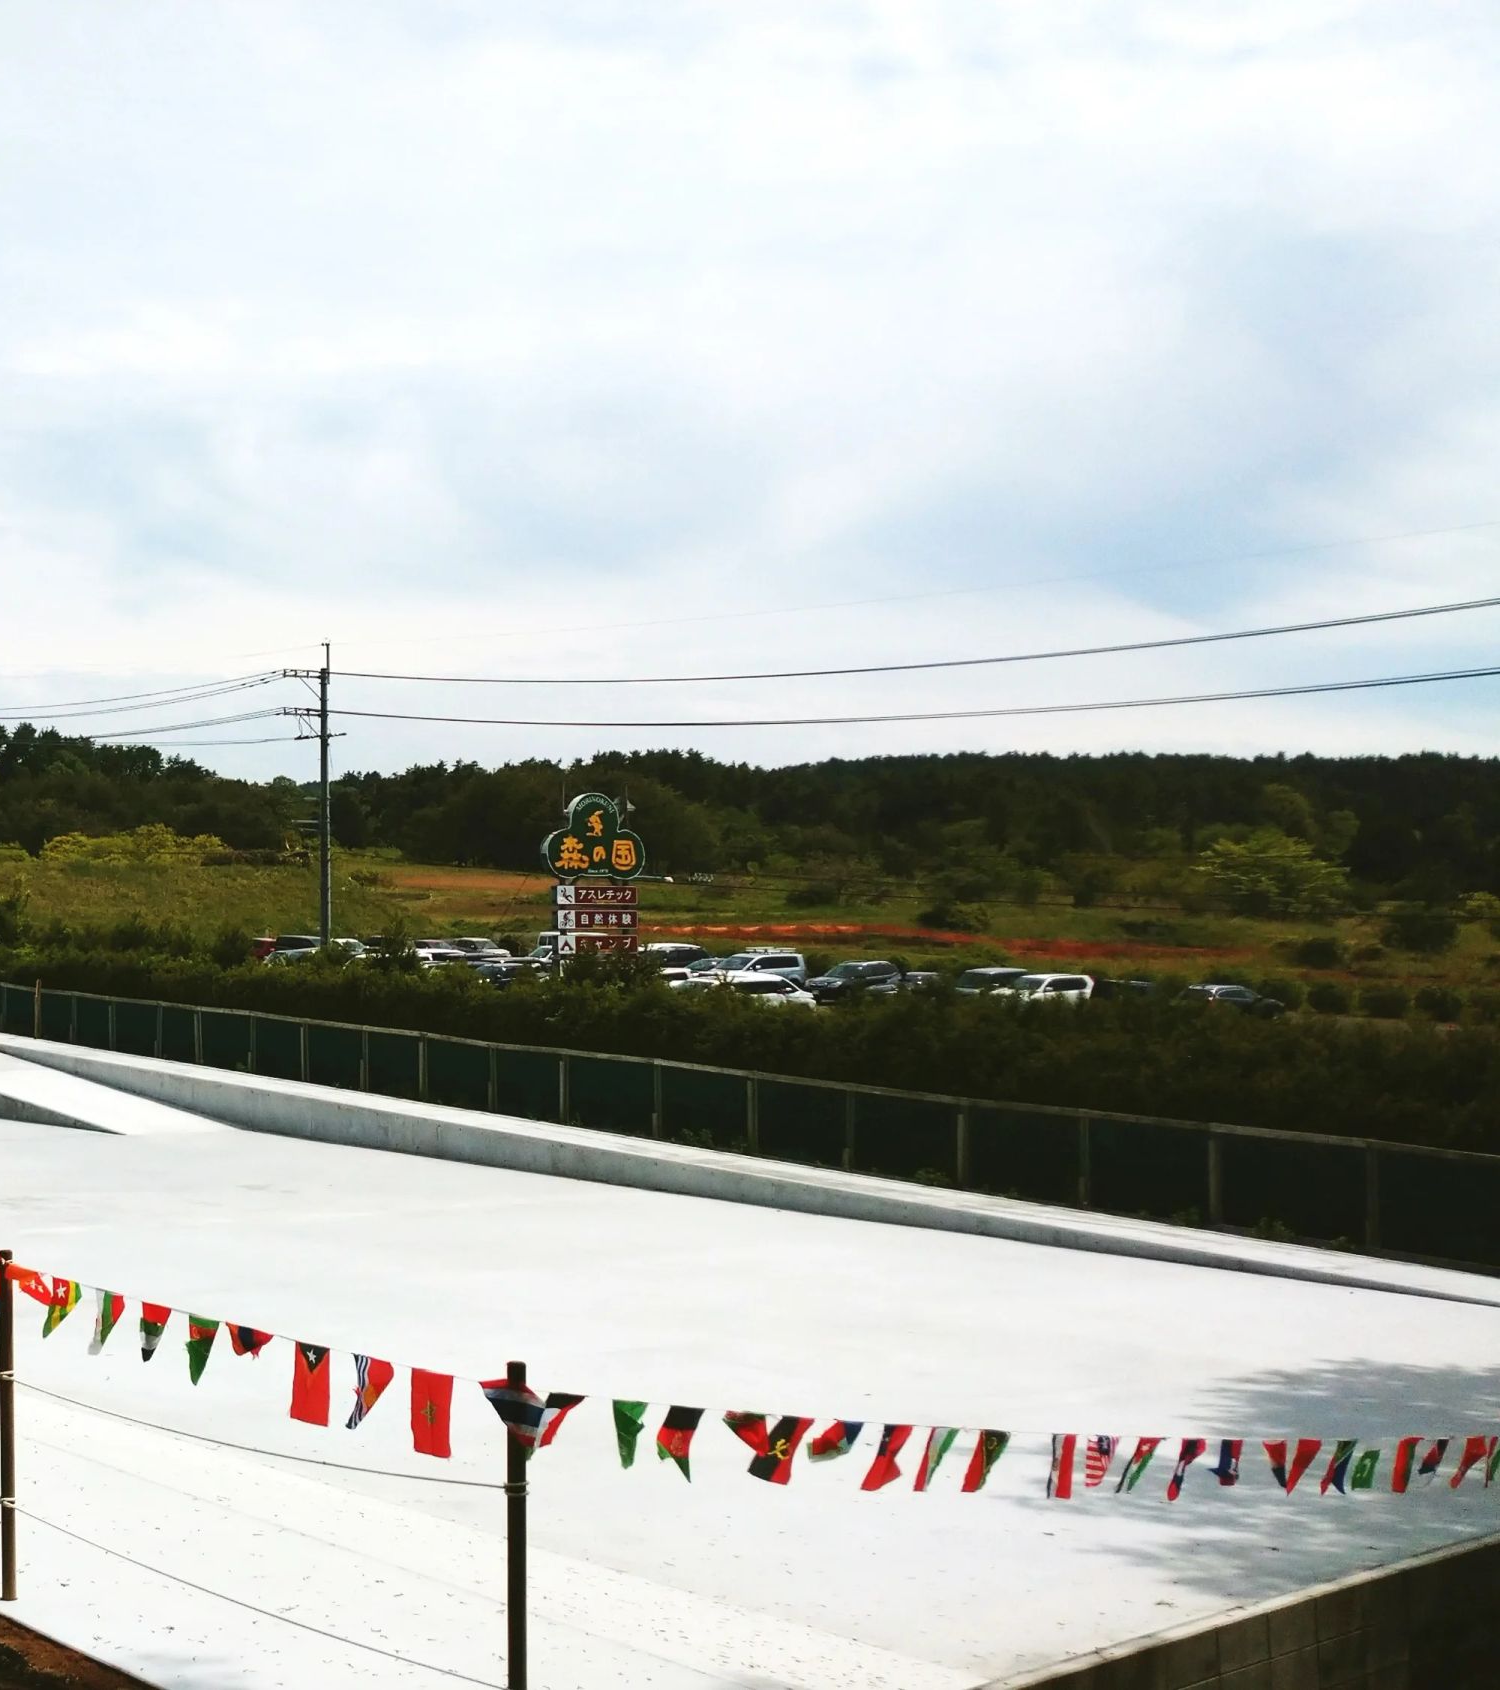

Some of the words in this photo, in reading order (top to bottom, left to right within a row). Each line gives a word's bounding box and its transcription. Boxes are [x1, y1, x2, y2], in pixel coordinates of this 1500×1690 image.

[555, 836, 636, 871] 森の国
[578, 889, 632, 901] アスレチック
[581, 913, 632, 925] 自然体験
